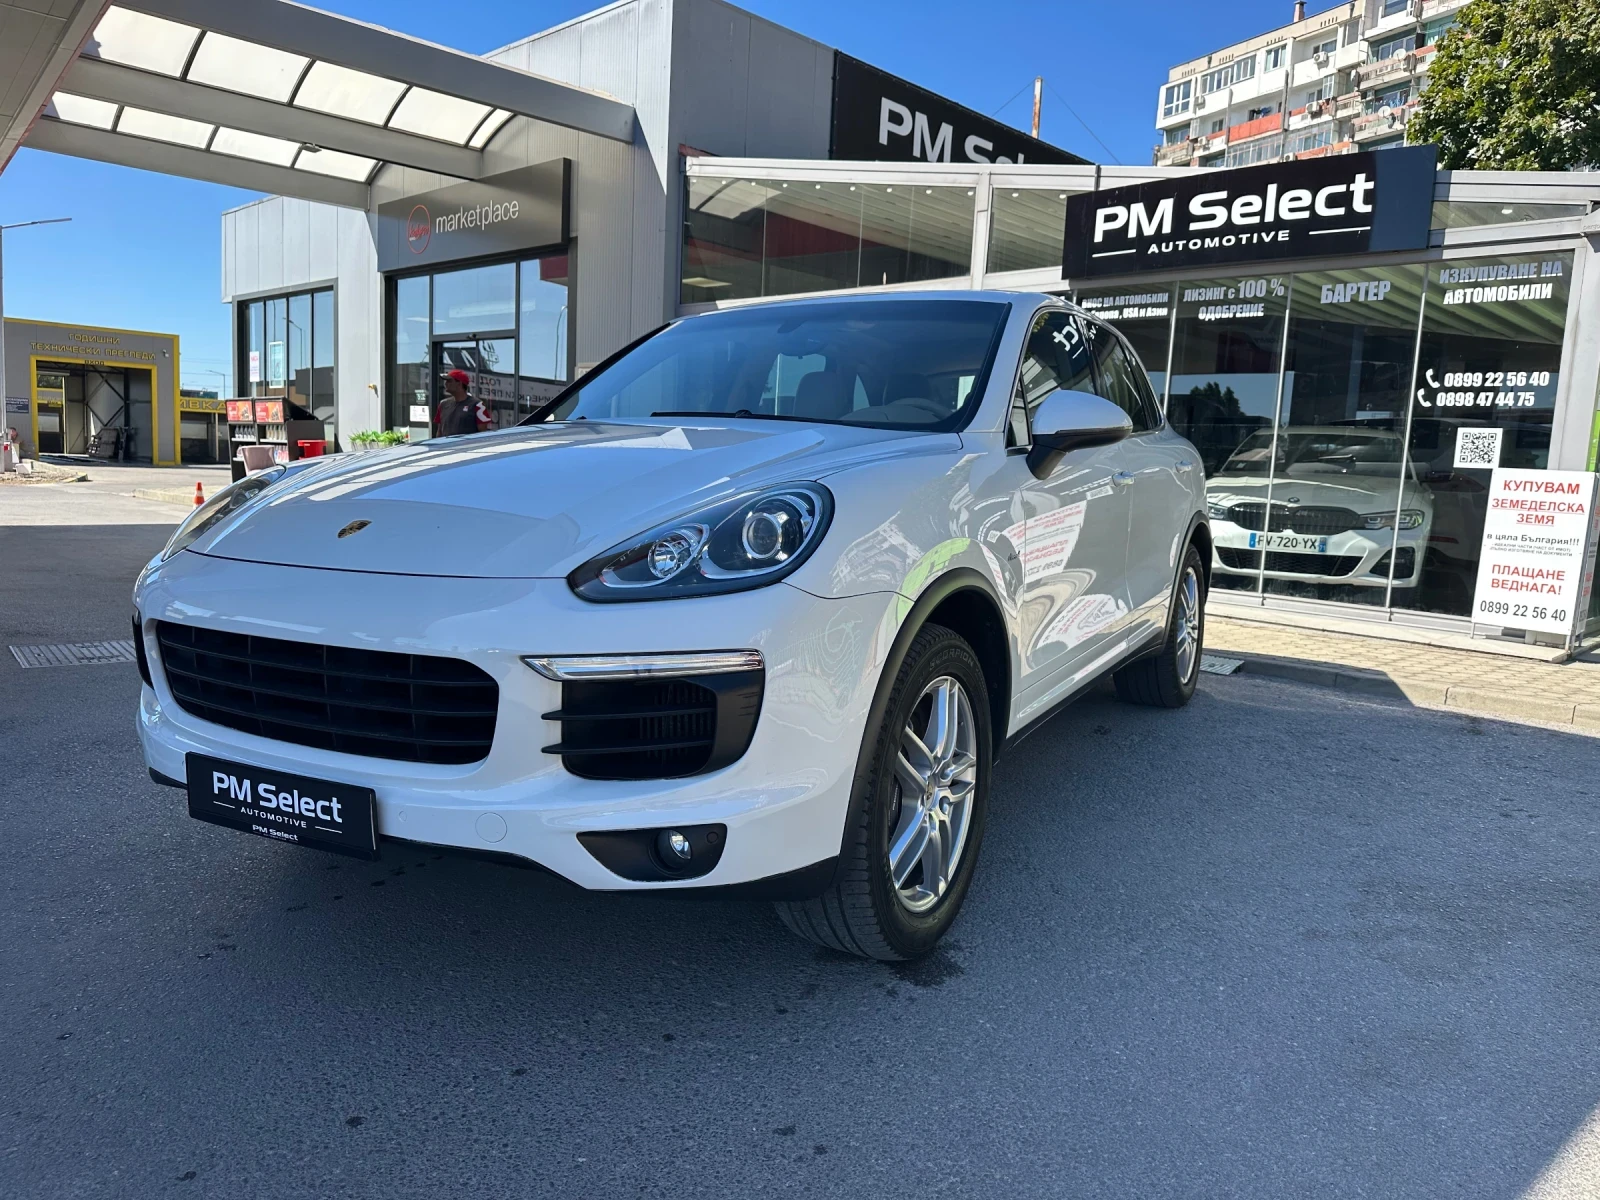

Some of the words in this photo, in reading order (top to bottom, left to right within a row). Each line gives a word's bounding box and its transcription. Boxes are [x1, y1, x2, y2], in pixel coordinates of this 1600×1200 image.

[878, 96, 954, 163] PM
[436, 200, 519, 234] marketplace
[1093, 198, 1174, 243] PM
[1189, 173, 1374, 231] Select
[1148, 230, 1290, 254] AUTOMOTIVE
[1440, 262, 1538, 284] ИЗКУПУВАНЕ
[1540, 260, 1562, 276] НА
[1183, 287, 1226, 302] ЛИЗИНГ
[1238, 279, 1266, 298] 100
[1320, 280, 1390, 304] БАРТЕР
[1443, 283, 1553, 304] АВТОМОБИЛИ
[1082, 298, 1102, 308] ВНОС
[1103, 296, 1114, 307] НА
[1114, 292, 1169, 306] АВТОМОБИЛИ
[1122, 308, 1139, 318] USA
[1146, 307, 1168, 317] Азии
[1198, 303, 1265, 322] ОДОБРЕНИЕ
[68, 333, 120, 344] ГОДИШНИ
[30, 342, 101, 354] ТЕХНИЧЕСКИ
[105, 348, 156, 360] ПРЕГЛЕДИ
[1444, 372, 1482, 388] 0899
[1484, 372, 1505, 387] 22
[1506, 372, 1526, 387] 56
[1528, 371, 1550, 387] 40
[1436, 392, 1474, 407] 0898
[1476, 392, 1496, 407] 47
[1495, 392, 1516, 407] 44
[1517, 391, 1535, 407] 75
[1504, 480, 1580, 494] КУПУВАМ
[1492, 498, 1585, 513] ЗЕМЕДЕЛСКА
[1517, 514, 1555, 525] ЗЕМЯ
[1521, 534, 1580, 546] България!!!
[1492, 564, 1565, 581] ПЛАЩАНЕ
[1492, 578, 1561, 595] ВЕДНАГА!
[1480, 600, 1508, 614] 0899
[1513, 604, 1528, 616] 22
[1532, 606, 1547, 619] 56
[1551, 610, 1566, 622] 40
[213, 771, 251, 802] PM
[258, 783, 342, 823] Select
[240, 806, 307, 828] AUTOMOTIVE
[252, 824, 268, 834] PM
[270, 829, 298, 841] Select
